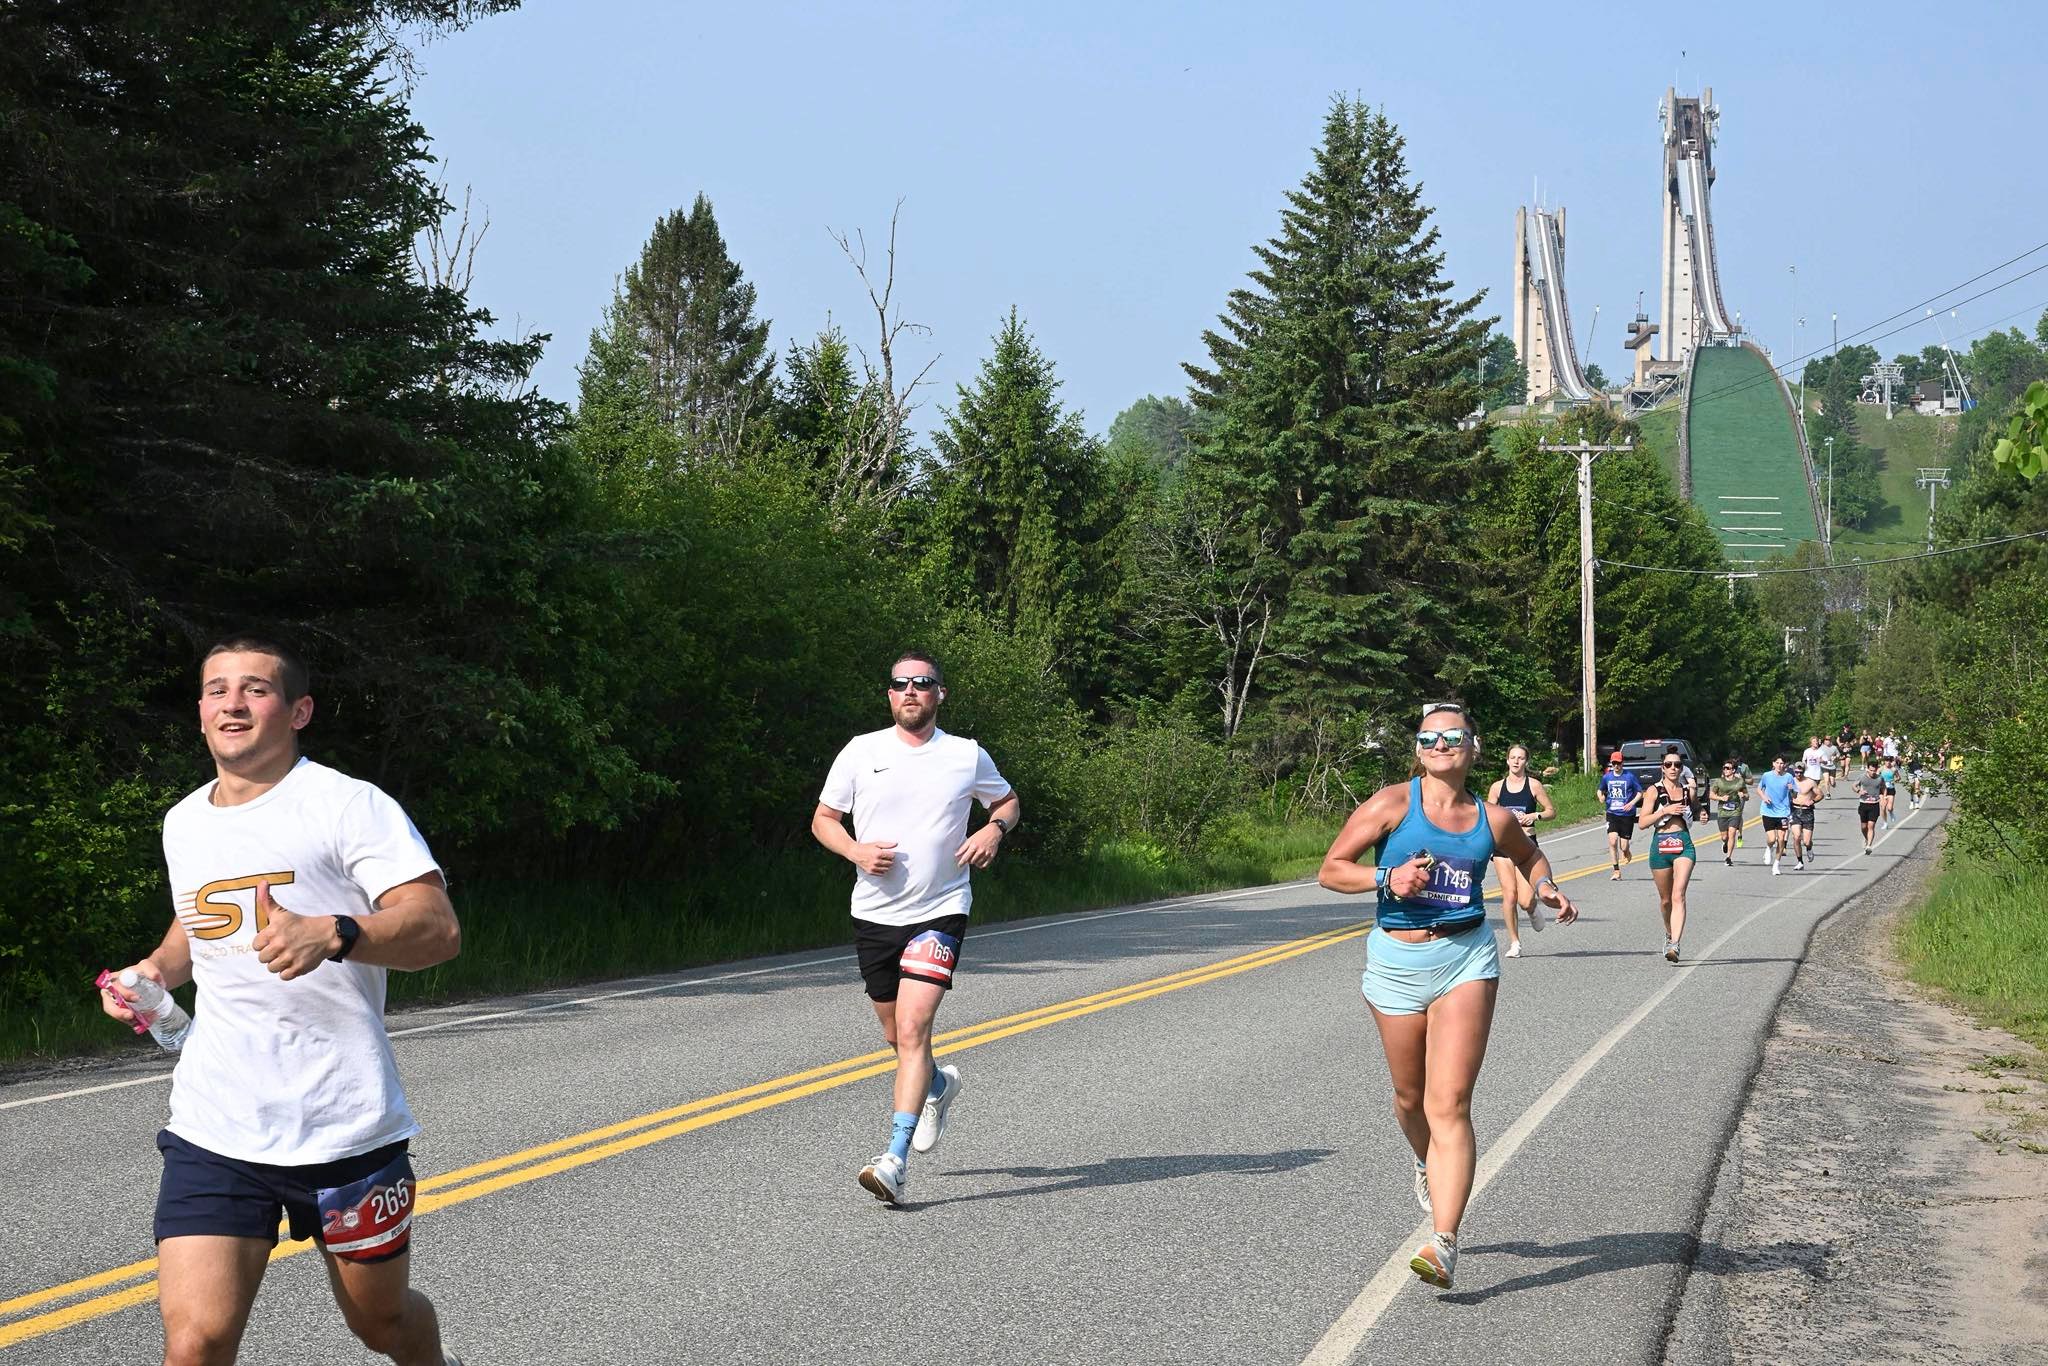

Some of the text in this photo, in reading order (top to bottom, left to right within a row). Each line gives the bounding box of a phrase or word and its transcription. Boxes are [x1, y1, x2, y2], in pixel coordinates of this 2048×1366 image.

[1434, 868, 1470, 889] 1145
[928, 942, 951, 962] 165
[371, 1177, 410, 1225] 265
